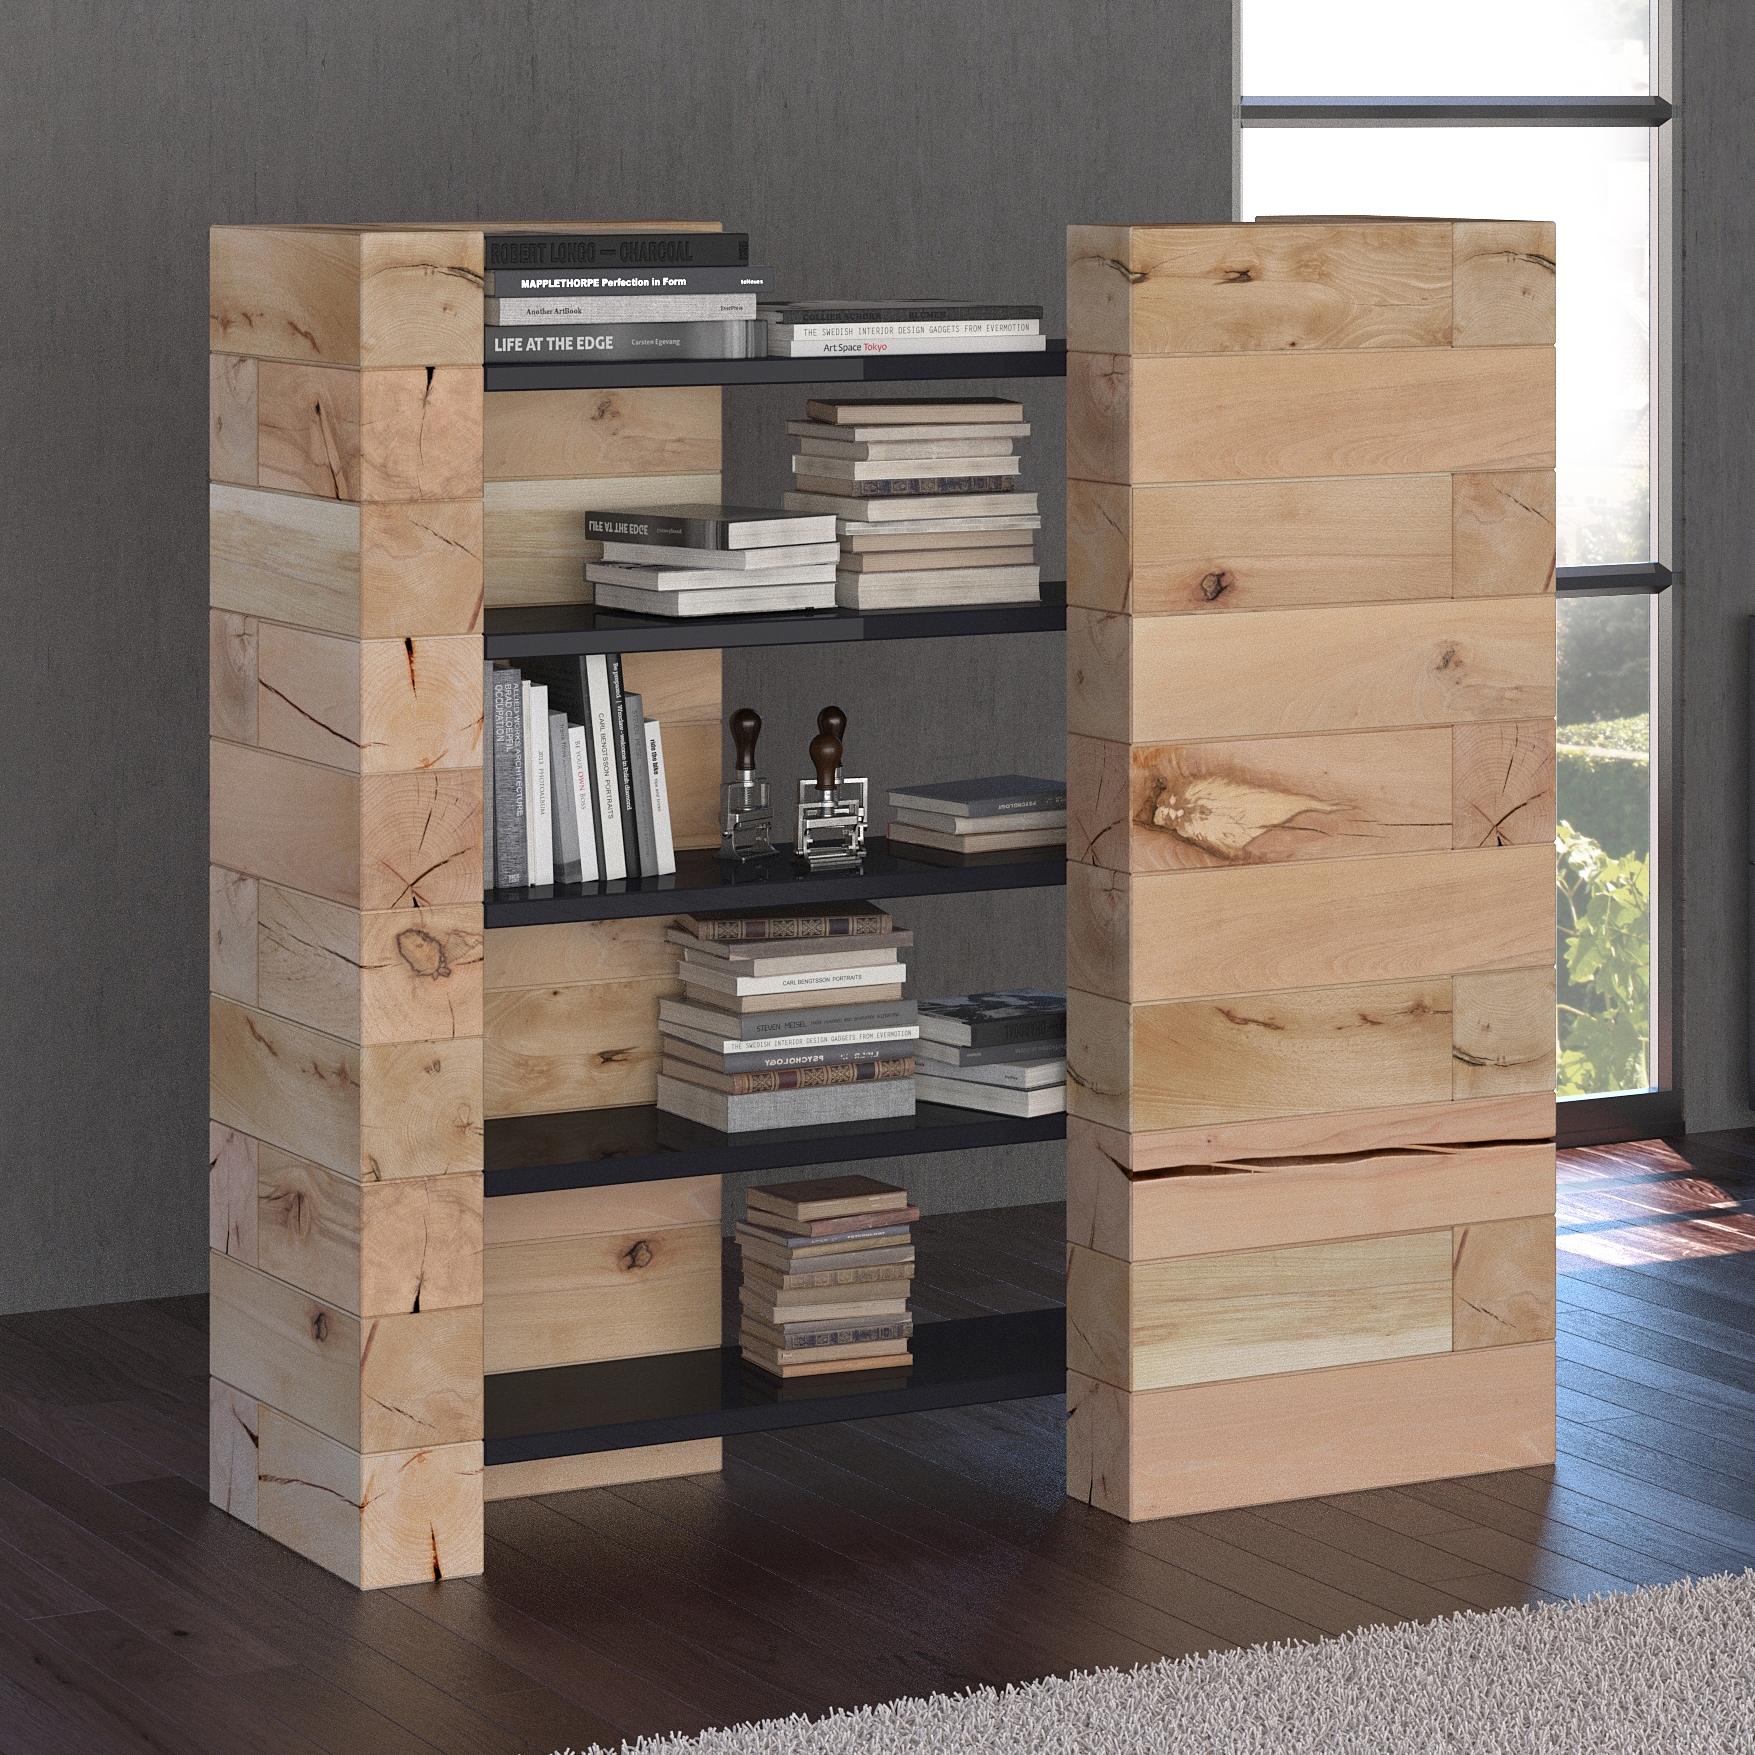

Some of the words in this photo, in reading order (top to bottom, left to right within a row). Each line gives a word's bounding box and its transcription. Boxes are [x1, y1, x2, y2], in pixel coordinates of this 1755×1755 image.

[490, 242, 547, 264] ROBERT
[550, 241, 597, 264] LONGO
[619, 241, 694, 263] CHARCOAL
[521, 278, 600, 289] MAPPLETHORPE
[601, 278, 650, 288] Perfection
[651, 278, 661, 287] in
[662, 277, 687, 287] Form
[526, 307, 553, 315] Another
[553, 307, 582, 315] ArtBook
[802, 312, 842, 321] COLLIER
[844, 312, 882, 321] SCHORR
[908, 311, 948, 320] BLUMEN
[803, 328, 818, 337] THE
[821, 327, 854, 336] SWEDISH
[857, 326, 894, 336] INTERIOR
[897, 326, 926, 335] DESIGN
[928, 325, 960, 334] GADGETS
[964, 324, 982, 333] FROM
[986, 324, 1030, 332] EVERMOTION
[494, 338, 523, 352] LIFE
[525, 337, 545, 351] AT
[546, 336, 573, 351] THE
[576, 336, 614, 350] EDGE
[631, 338, 655, 346] Carsten
[655, 337, 681, 347] Egevang
[823, 343, 837, 352] Art
[838, 343, 862, 353] Space
[863, 342, 888, 353] Tokyo
[612, 663, 619, 671] Be
[612, 671, 622, 698] prepared
[504, 683, 513, 708] BRAD
[512, 683, 520, 714] ALLIED
[495, 684, 505, 742] OCCUPATION
[598, 713, 606, 732] CARL
[631, 710, 640, 735] STEVEN
[505, 710, 514, 752] CLOEPFIL
[513, 715, 522, 747] WORKS
[600, 733, 610, 777] BENGTSSON
[620, 734, 628, 760] welcome
[649, 739, 657, 751] ride
[515, 748, 524, 817] ARCHITECTURE
[577, 771, 585, 791] OWN
[604, 779, 614, 820] PORTRAITS
[625, 784, 633, 811] diamond
[782, 978, 796, 987] CARL
[797, 976, 831, 985] BENGTSSON
[832, 974, 862, 983] PORTRAITS
[756, 1021, 782, 1031] STEVEN
[784, 1020, 807, 1030] MEISEL
[745, 1041, 771, 1050] SWEDISH
[774, 1038, 803, 1048] INTERIOR
[806, 1036, 828, 1045] DESIGN
[830, 1034, 856, 1043] GADGETS
[859, 1032, 874, 1041] FROM
[876, 1030, 912, 1039] EVERMOTION
